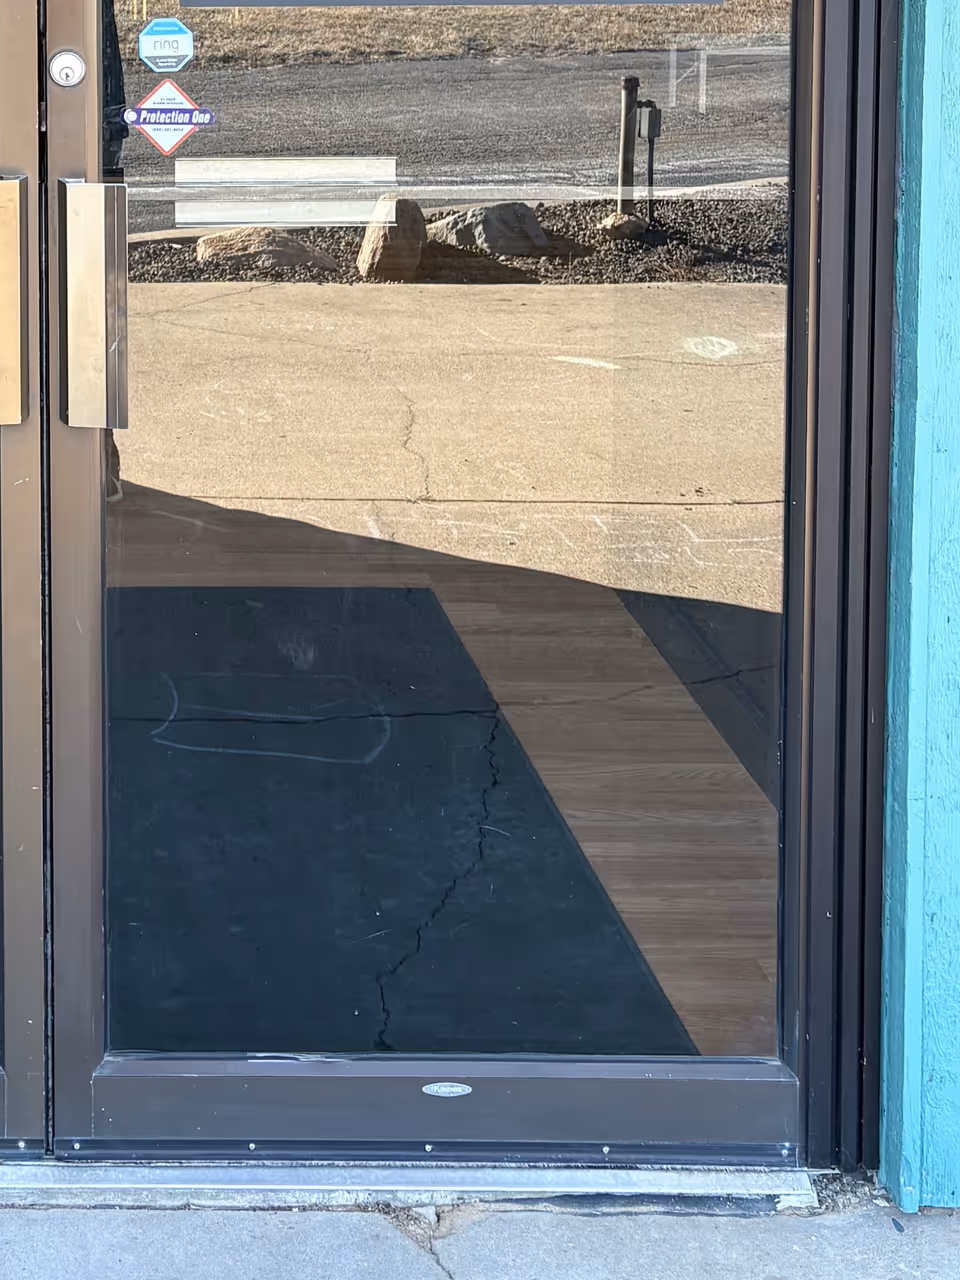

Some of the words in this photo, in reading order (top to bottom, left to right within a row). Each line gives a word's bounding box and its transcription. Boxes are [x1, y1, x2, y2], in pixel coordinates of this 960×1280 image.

[153, 38, 179, 53] ring
[140, 110, 190, 123] Protection
[191, 110, 211, 124] One
